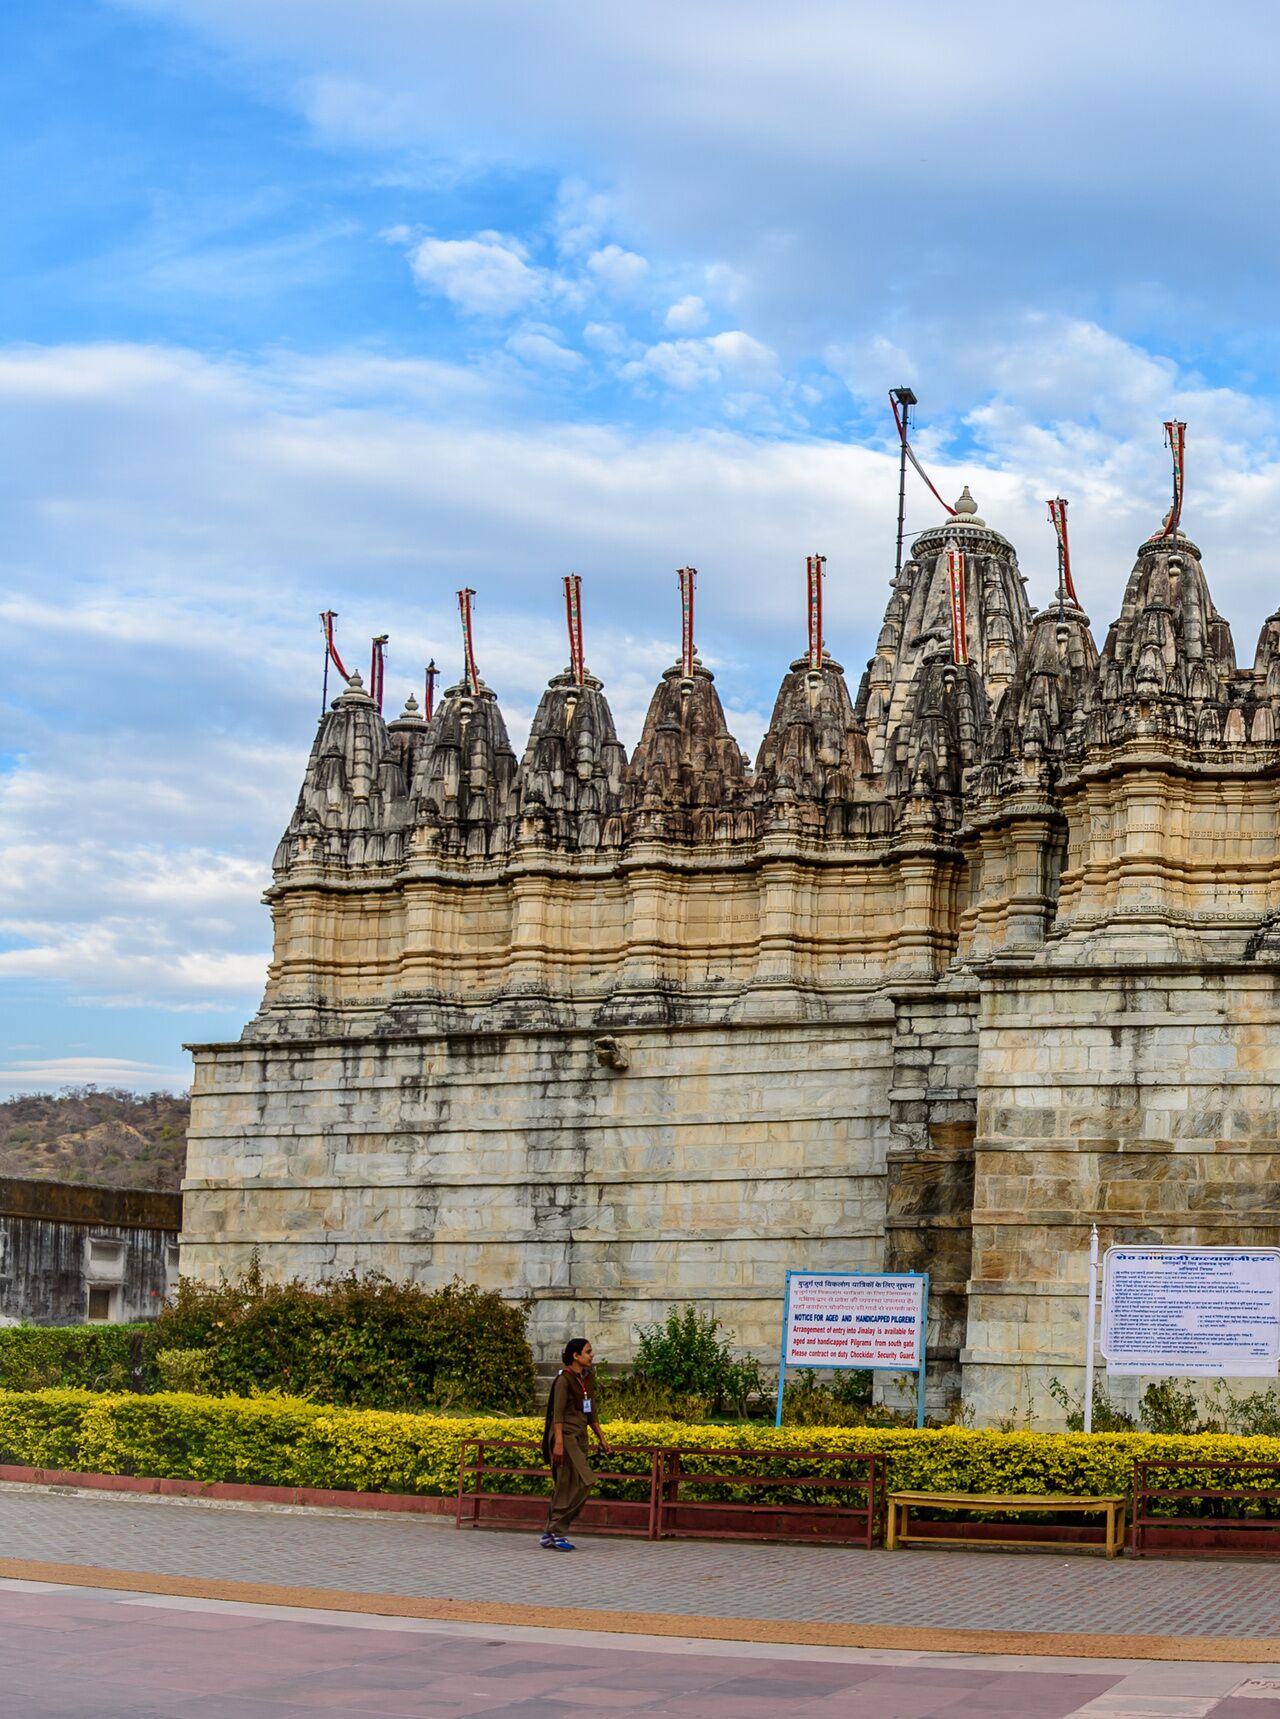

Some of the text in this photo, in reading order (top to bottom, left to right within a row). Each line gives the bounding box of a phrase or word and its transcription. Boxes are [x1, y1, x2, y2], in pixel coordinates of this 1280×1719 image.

[793, 1325, 825, 1334] Arrangement
[833, 1327, 845, 1335] entry
[857, 1327, 875, 1336] Jinalay
[817, 1338, 848, 1347] handicapped
[838, 1351, 848, 1359] duty
[877, 1351, 896, 1360] Security
